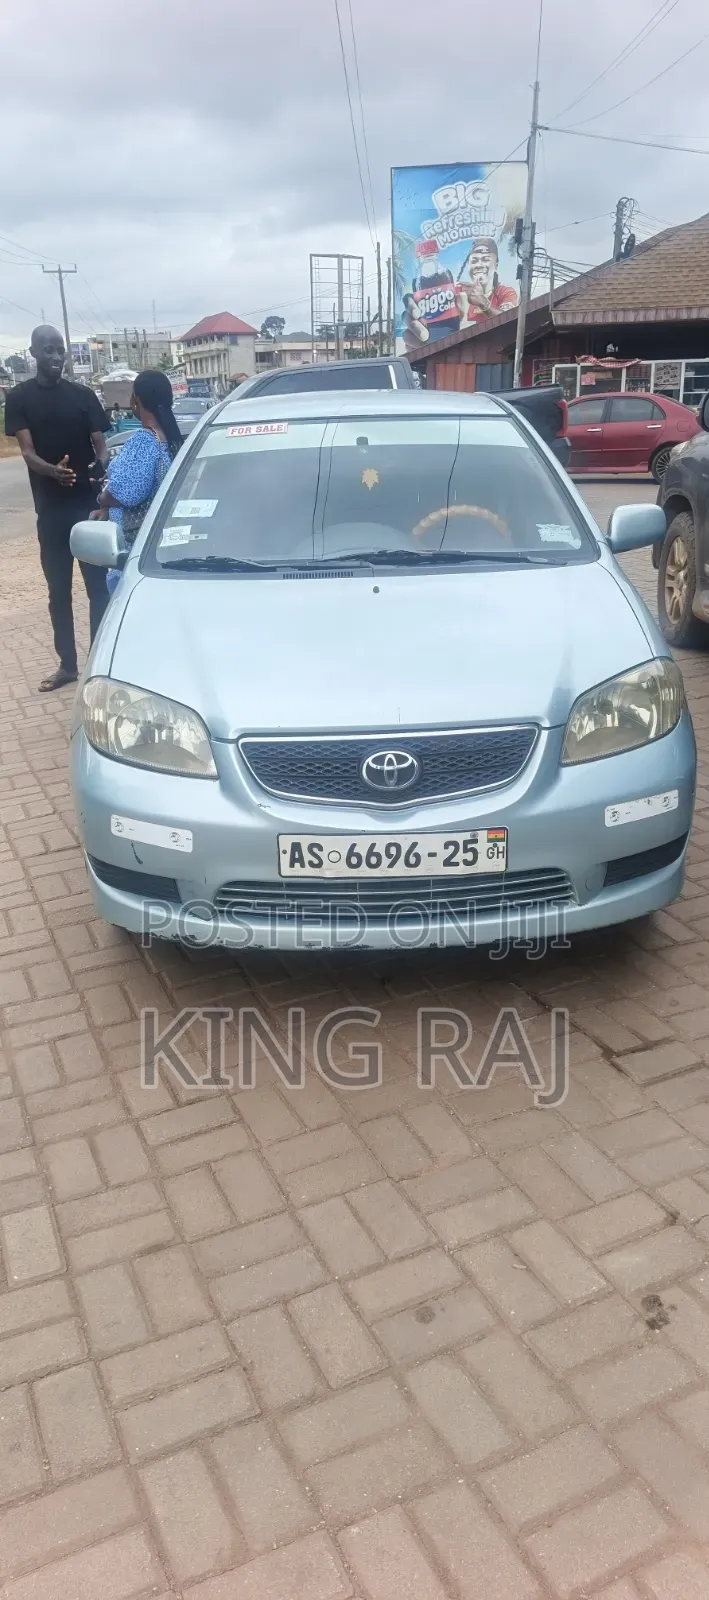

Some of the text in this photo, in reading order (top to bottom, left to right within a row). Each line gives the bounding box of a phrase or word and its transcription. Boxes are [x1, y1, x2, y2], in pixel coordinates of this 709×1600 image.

[434, 182, 490, 214] BIG
[230, 424, 284, 435] FOR SALE
[289, 839, 479, 869] AS 6696-25
[486, 845, 505, 859] GH
